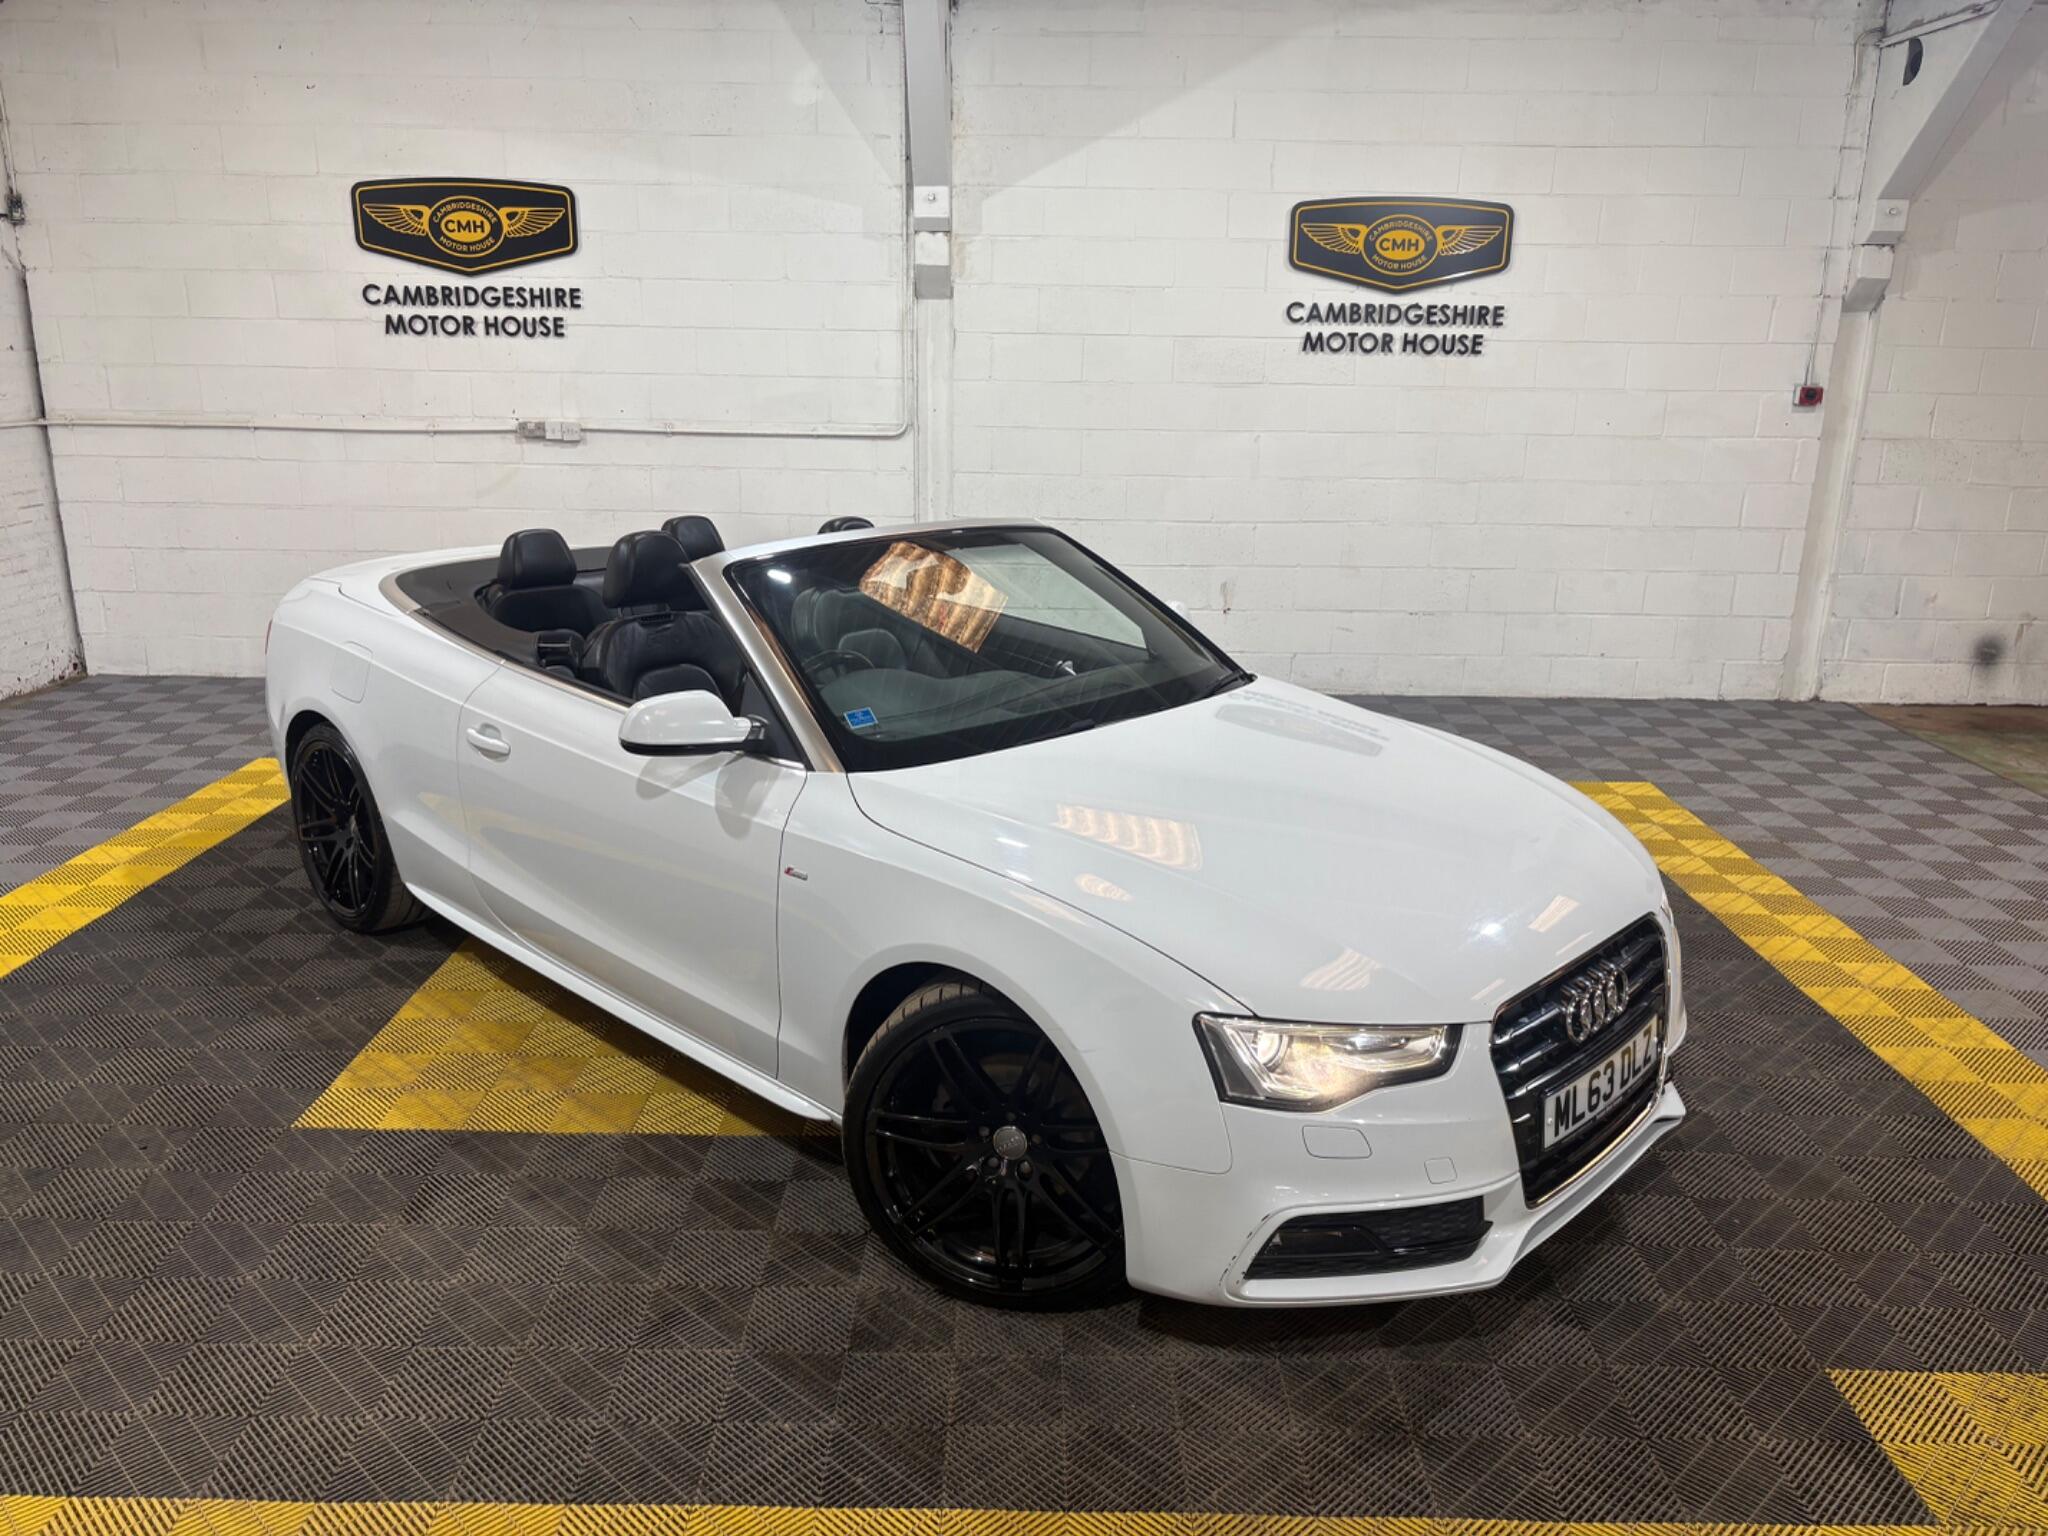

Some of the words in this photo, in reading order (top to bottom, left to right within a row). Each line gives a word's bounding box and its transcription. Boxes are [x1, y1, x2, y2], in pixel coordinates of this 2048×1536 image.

[433, 202, 498, 223] CAMBRIDGESHIRE
[444, 220, 485, 233] CMH
[1369, 220, 1433, 242] CAMBRIDGESHIRE
[439, 236, 468, 252] MOTOR
[469, 239, 495, 252] HOUSE
[1379, 238, 1419, 252] CMH
[1372, 254, 1399, 268] MOTOR
[1400, 256, 1427, 269] HOUSE
[362, 284, 582, 308] CAMBRIDGESHIRE
[1286, 302, 1505, 327] CAMBRIDGESHIRE
[385, 314, 475, 336] MOTOR
[484, 316, 565, 338] HOUSE
[1302, 332, 1393, 353] MOTOR
[1402, 333, 1484, 355] HOUSE
[1554, 1058, 1614, 1138] ML63
[1619, 1025, 1652, 1090] DLZ
